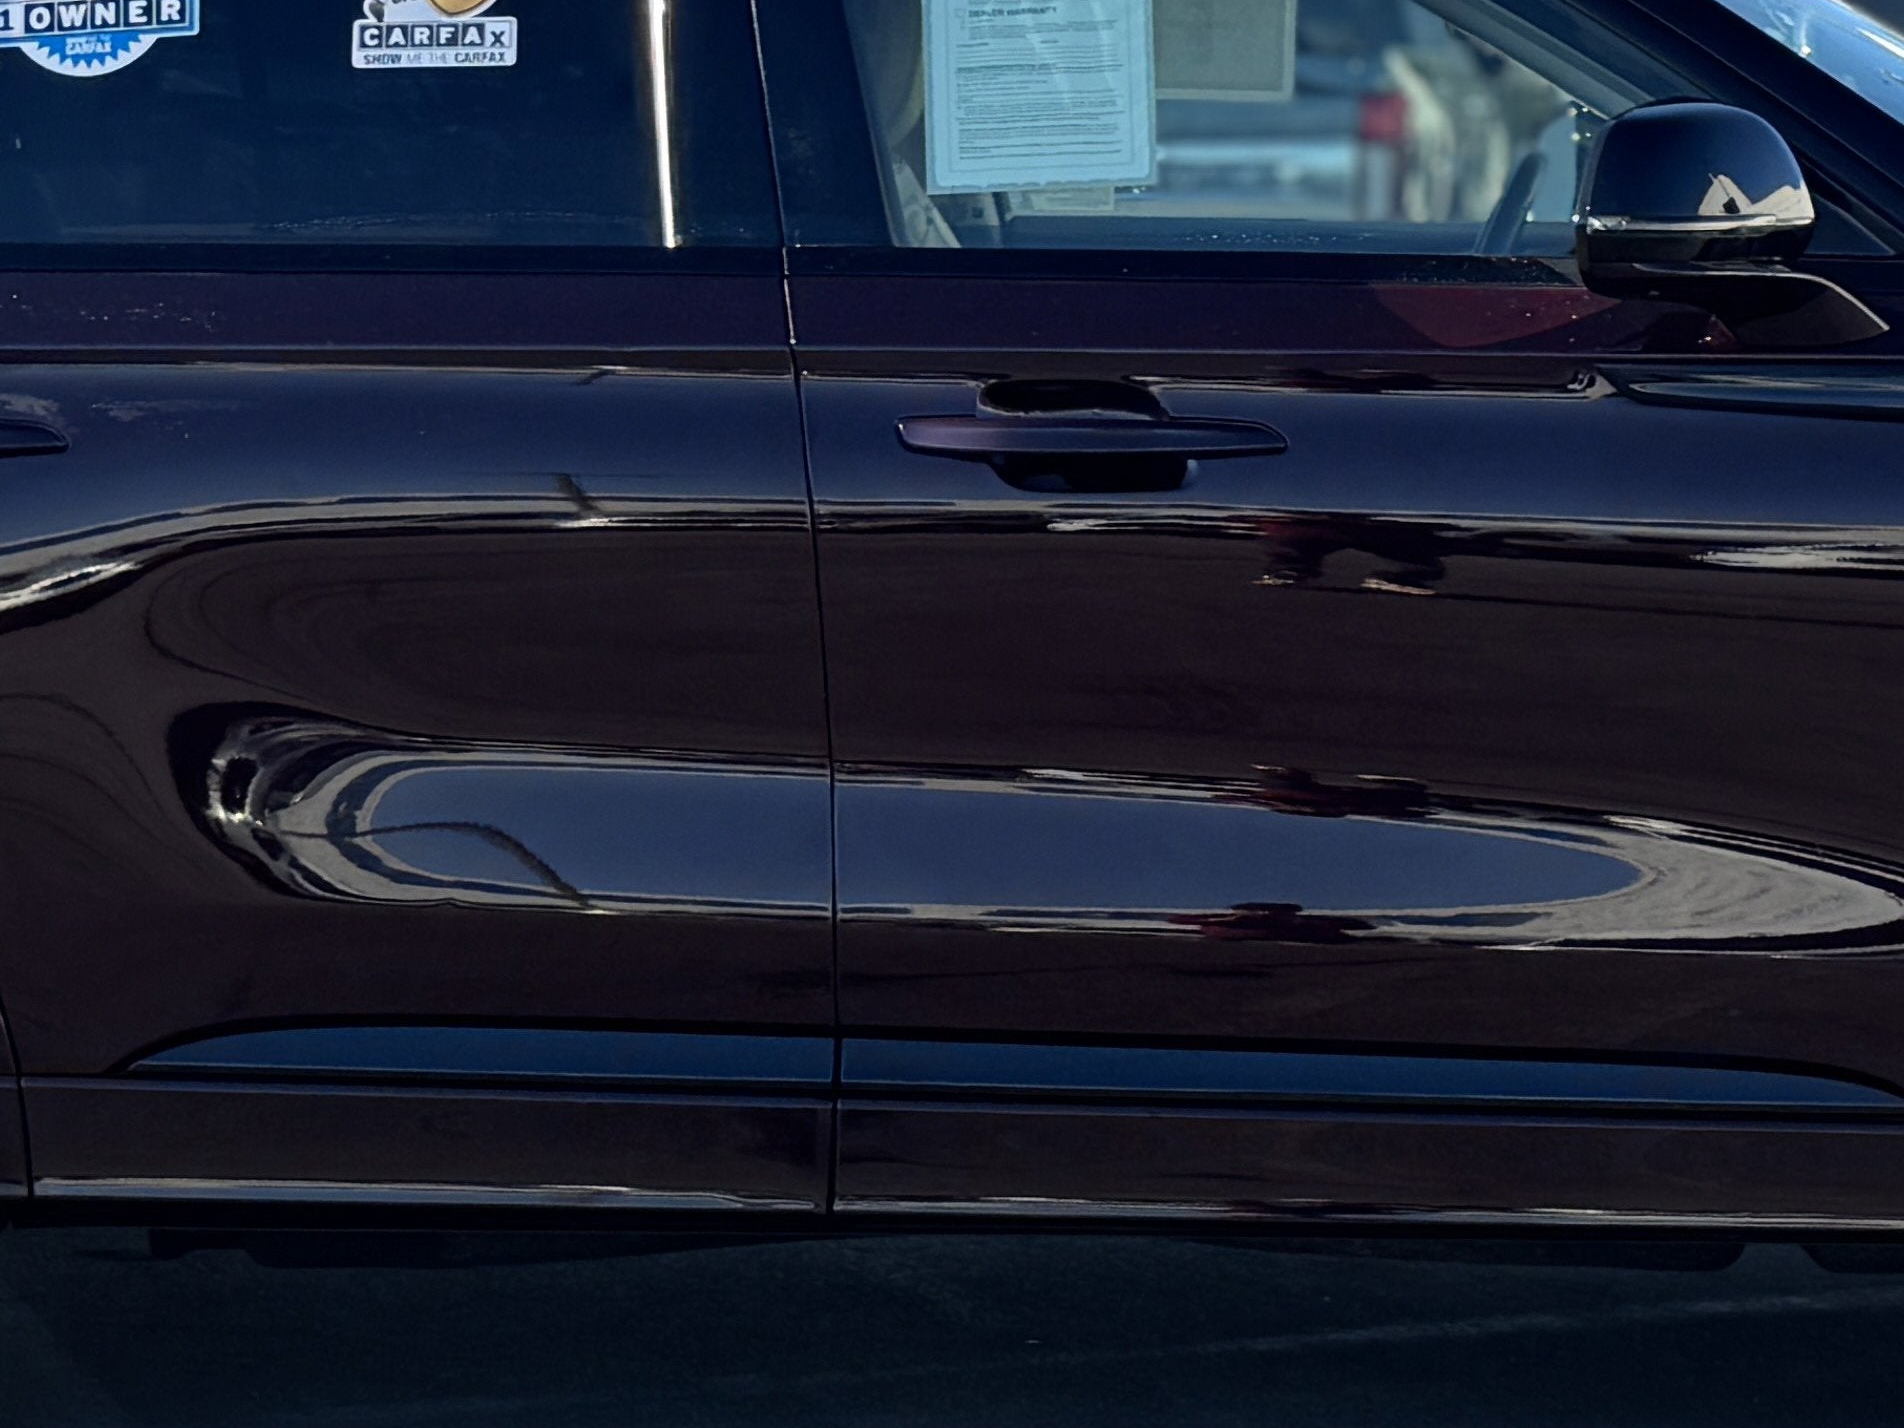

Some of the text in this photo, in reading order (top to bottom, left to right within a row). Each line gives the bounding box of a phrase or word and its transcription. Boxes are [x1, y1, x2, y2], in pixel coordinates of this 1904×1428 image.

[363, 26, 505, 48] CARFAX
[363, 54, 402, 65] SHOW
[454, 52, 506, 63] CARFAX
